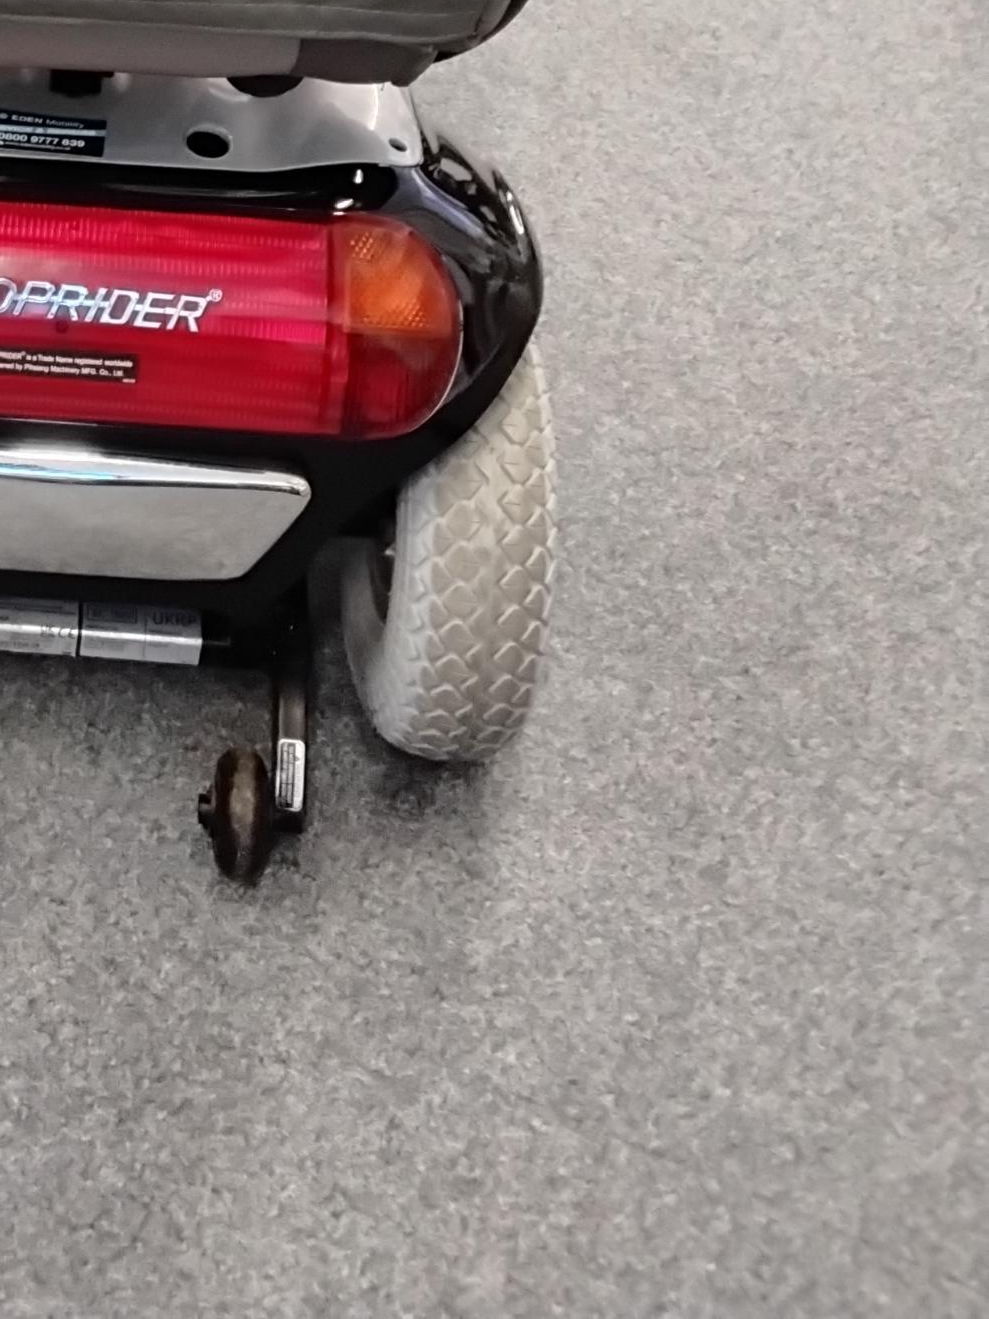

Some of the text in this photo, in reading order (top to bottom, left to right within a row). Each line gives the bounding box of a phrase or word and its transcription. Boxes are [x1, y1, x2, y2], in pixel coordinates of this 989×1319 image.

[11, 114, 84, 129] EDEN Mobility
[30, 135, 60, 146] 9777
[61, 138, 86, 148] 839
[38, 354, 55, 362] Trade
[56, 356, 74, 364] Name
[75, 357, 103, 366] registered
[104, 359, 133, 368] worldwide
[15, 363, 23, 371] by
[50, 365, 80, 375] Machinery
[81, 367, 98, 376] MFG.
